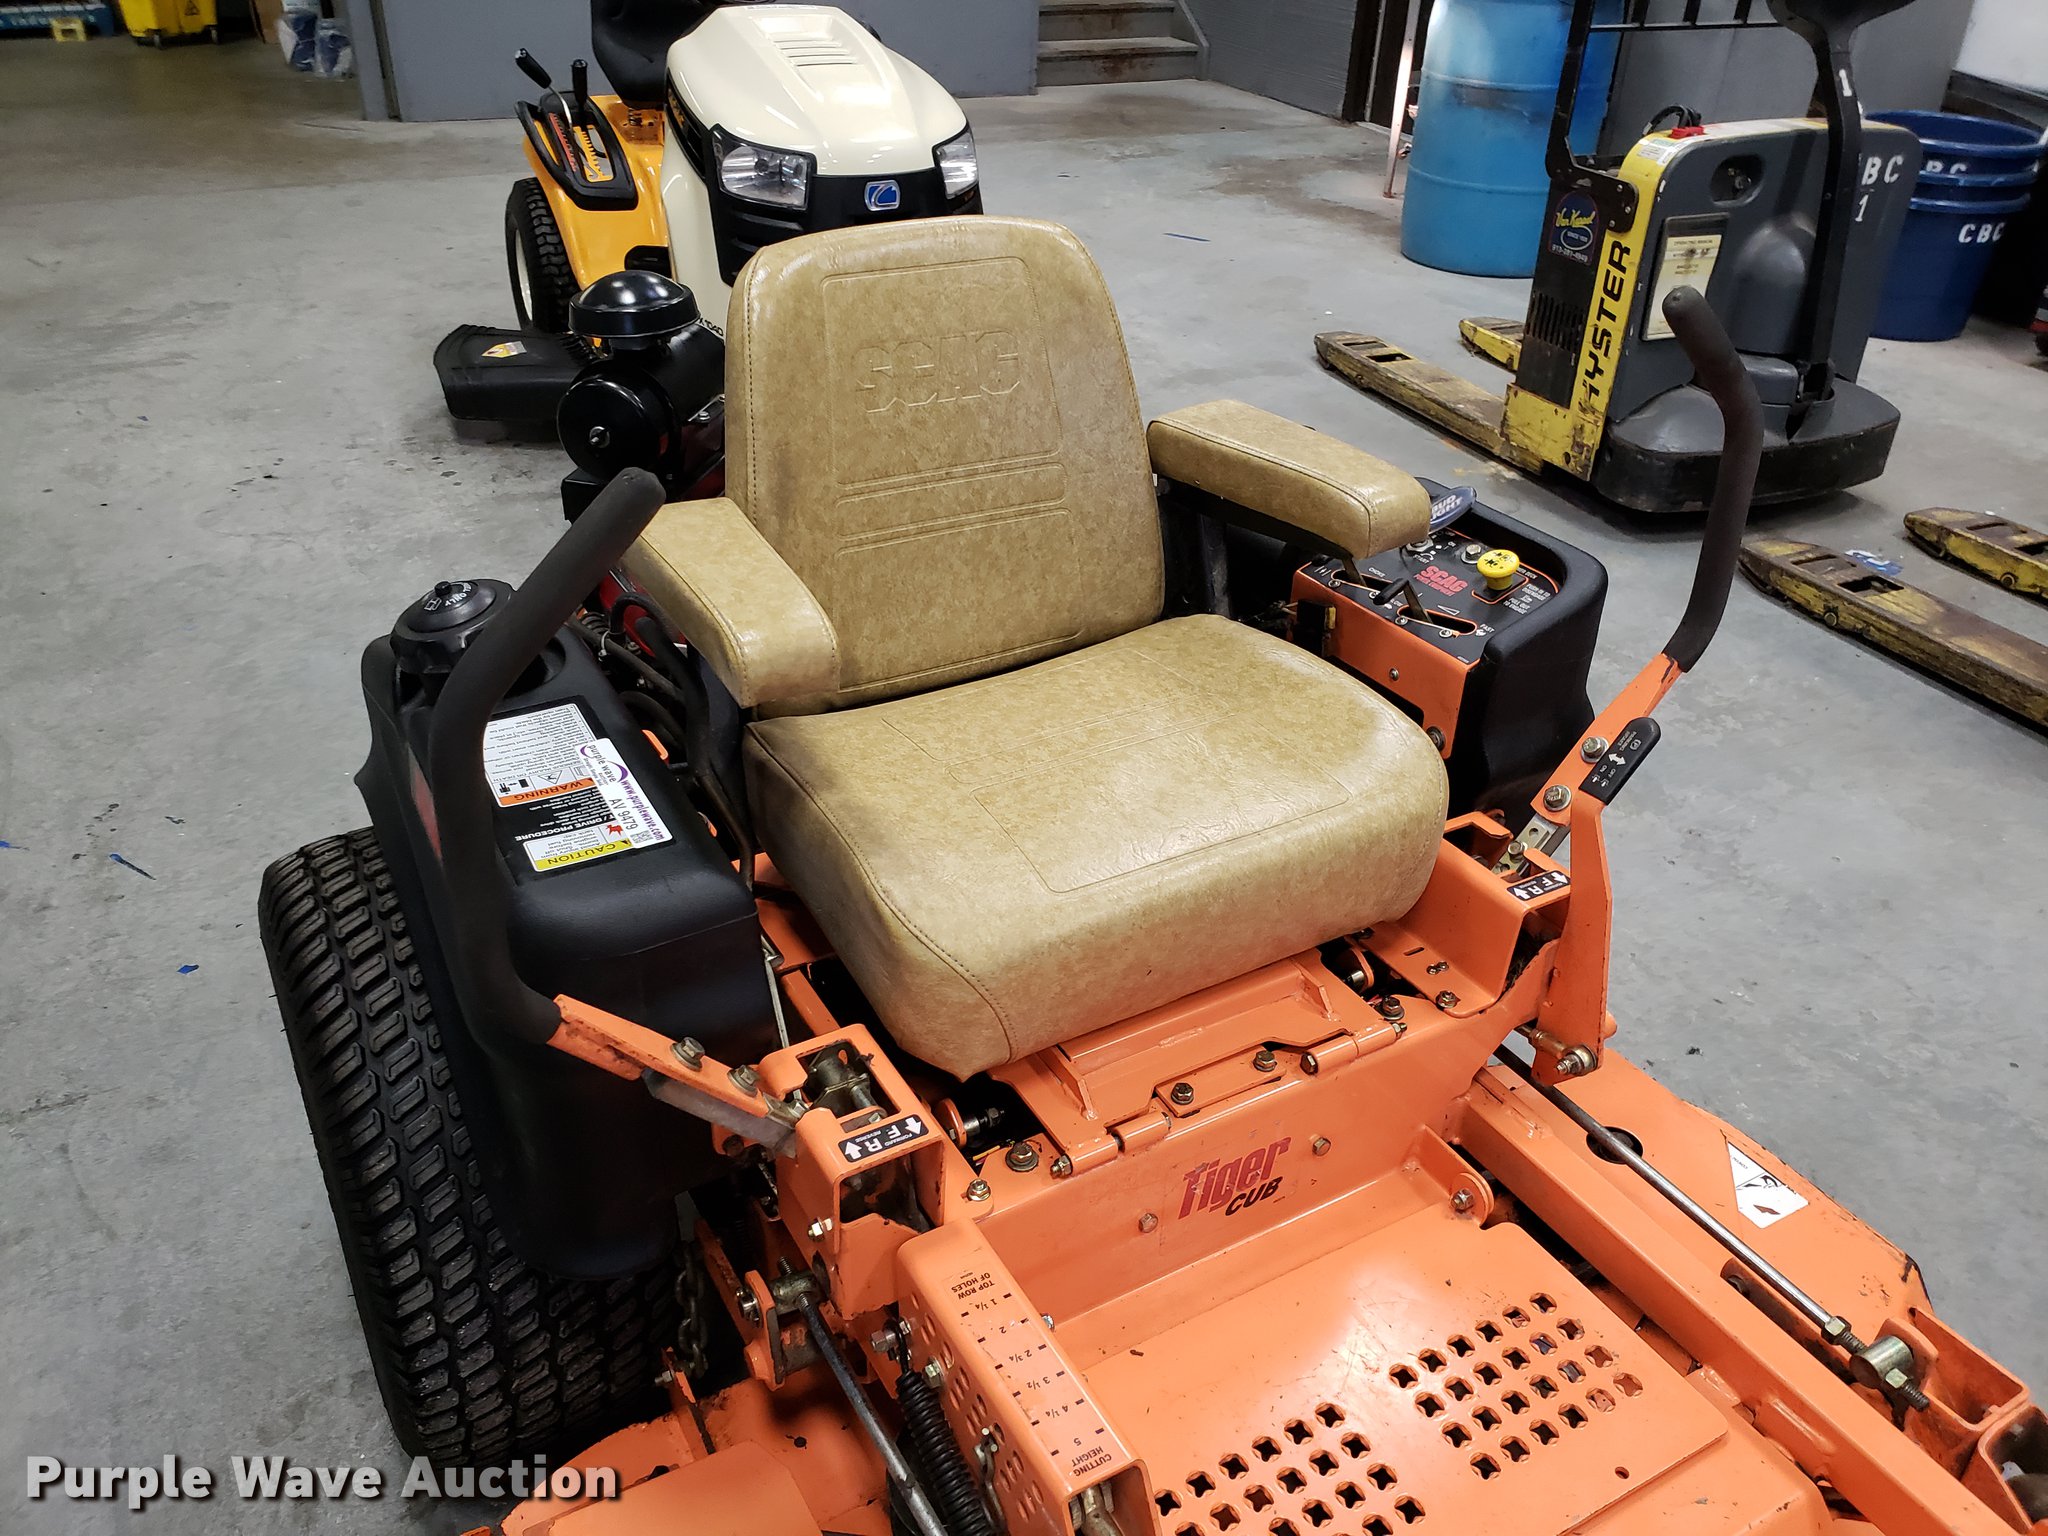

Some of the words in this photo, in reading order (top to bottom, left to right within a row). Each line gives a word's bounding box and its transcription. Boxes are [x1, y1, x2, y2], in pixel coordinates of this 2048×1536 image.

[1858, 154, 1904, 186] BC
[1855, 194, 1869, 222] 1
[1577, 240, 1632, 408] HYSTER
[853, 330, 1024, 414] SCAG
[1420, 565, 1468, 592] SCAG
[587, 744, 606, 765] purple
[601, 764, 617, 783] wave
[514, 781, 582, 801] WARNING
[608, 798, 628, 810] AV
[620, 779, 665, 841] www.purplewave.com
[575, 817, 603, 829] DRIVE
[617, 810, 639, 830] 9479
[514, 825, 574, 842] PROCEDURE
[547, 843, 616, 864] CAUTION
[1542, 877, 1553, 886] F
[1527, 885, 1544, 895] R
[884, 1132, 913, 1146] FORWARD
[887, 1124, 901, 1139] F
[864, 1138, 883, 1152] R
[1178, 1137, 1292, 1220] Tiger
[1225, 1176, 1283, 1216] CUB
[951, 1277, 979, 1293] HOLES
[980, 1272, 991, 1282] OF
[957, 1287, 977, 1300] ROW
[978, 1280, 996, 1291] TOP
[998, 1325, 1007, 1334] 2
[1024, 1349, 1033, 1358] 2
[1042, 1376, 1051, 1385] 3
[1061, 1405, 1069, 1413] 4
[1073, 1437, 1082, 1446] 5
[1071, 1446, 1104, 1468] HEIGHT
[1073, 1453, 1112, 1477] CUTTING
